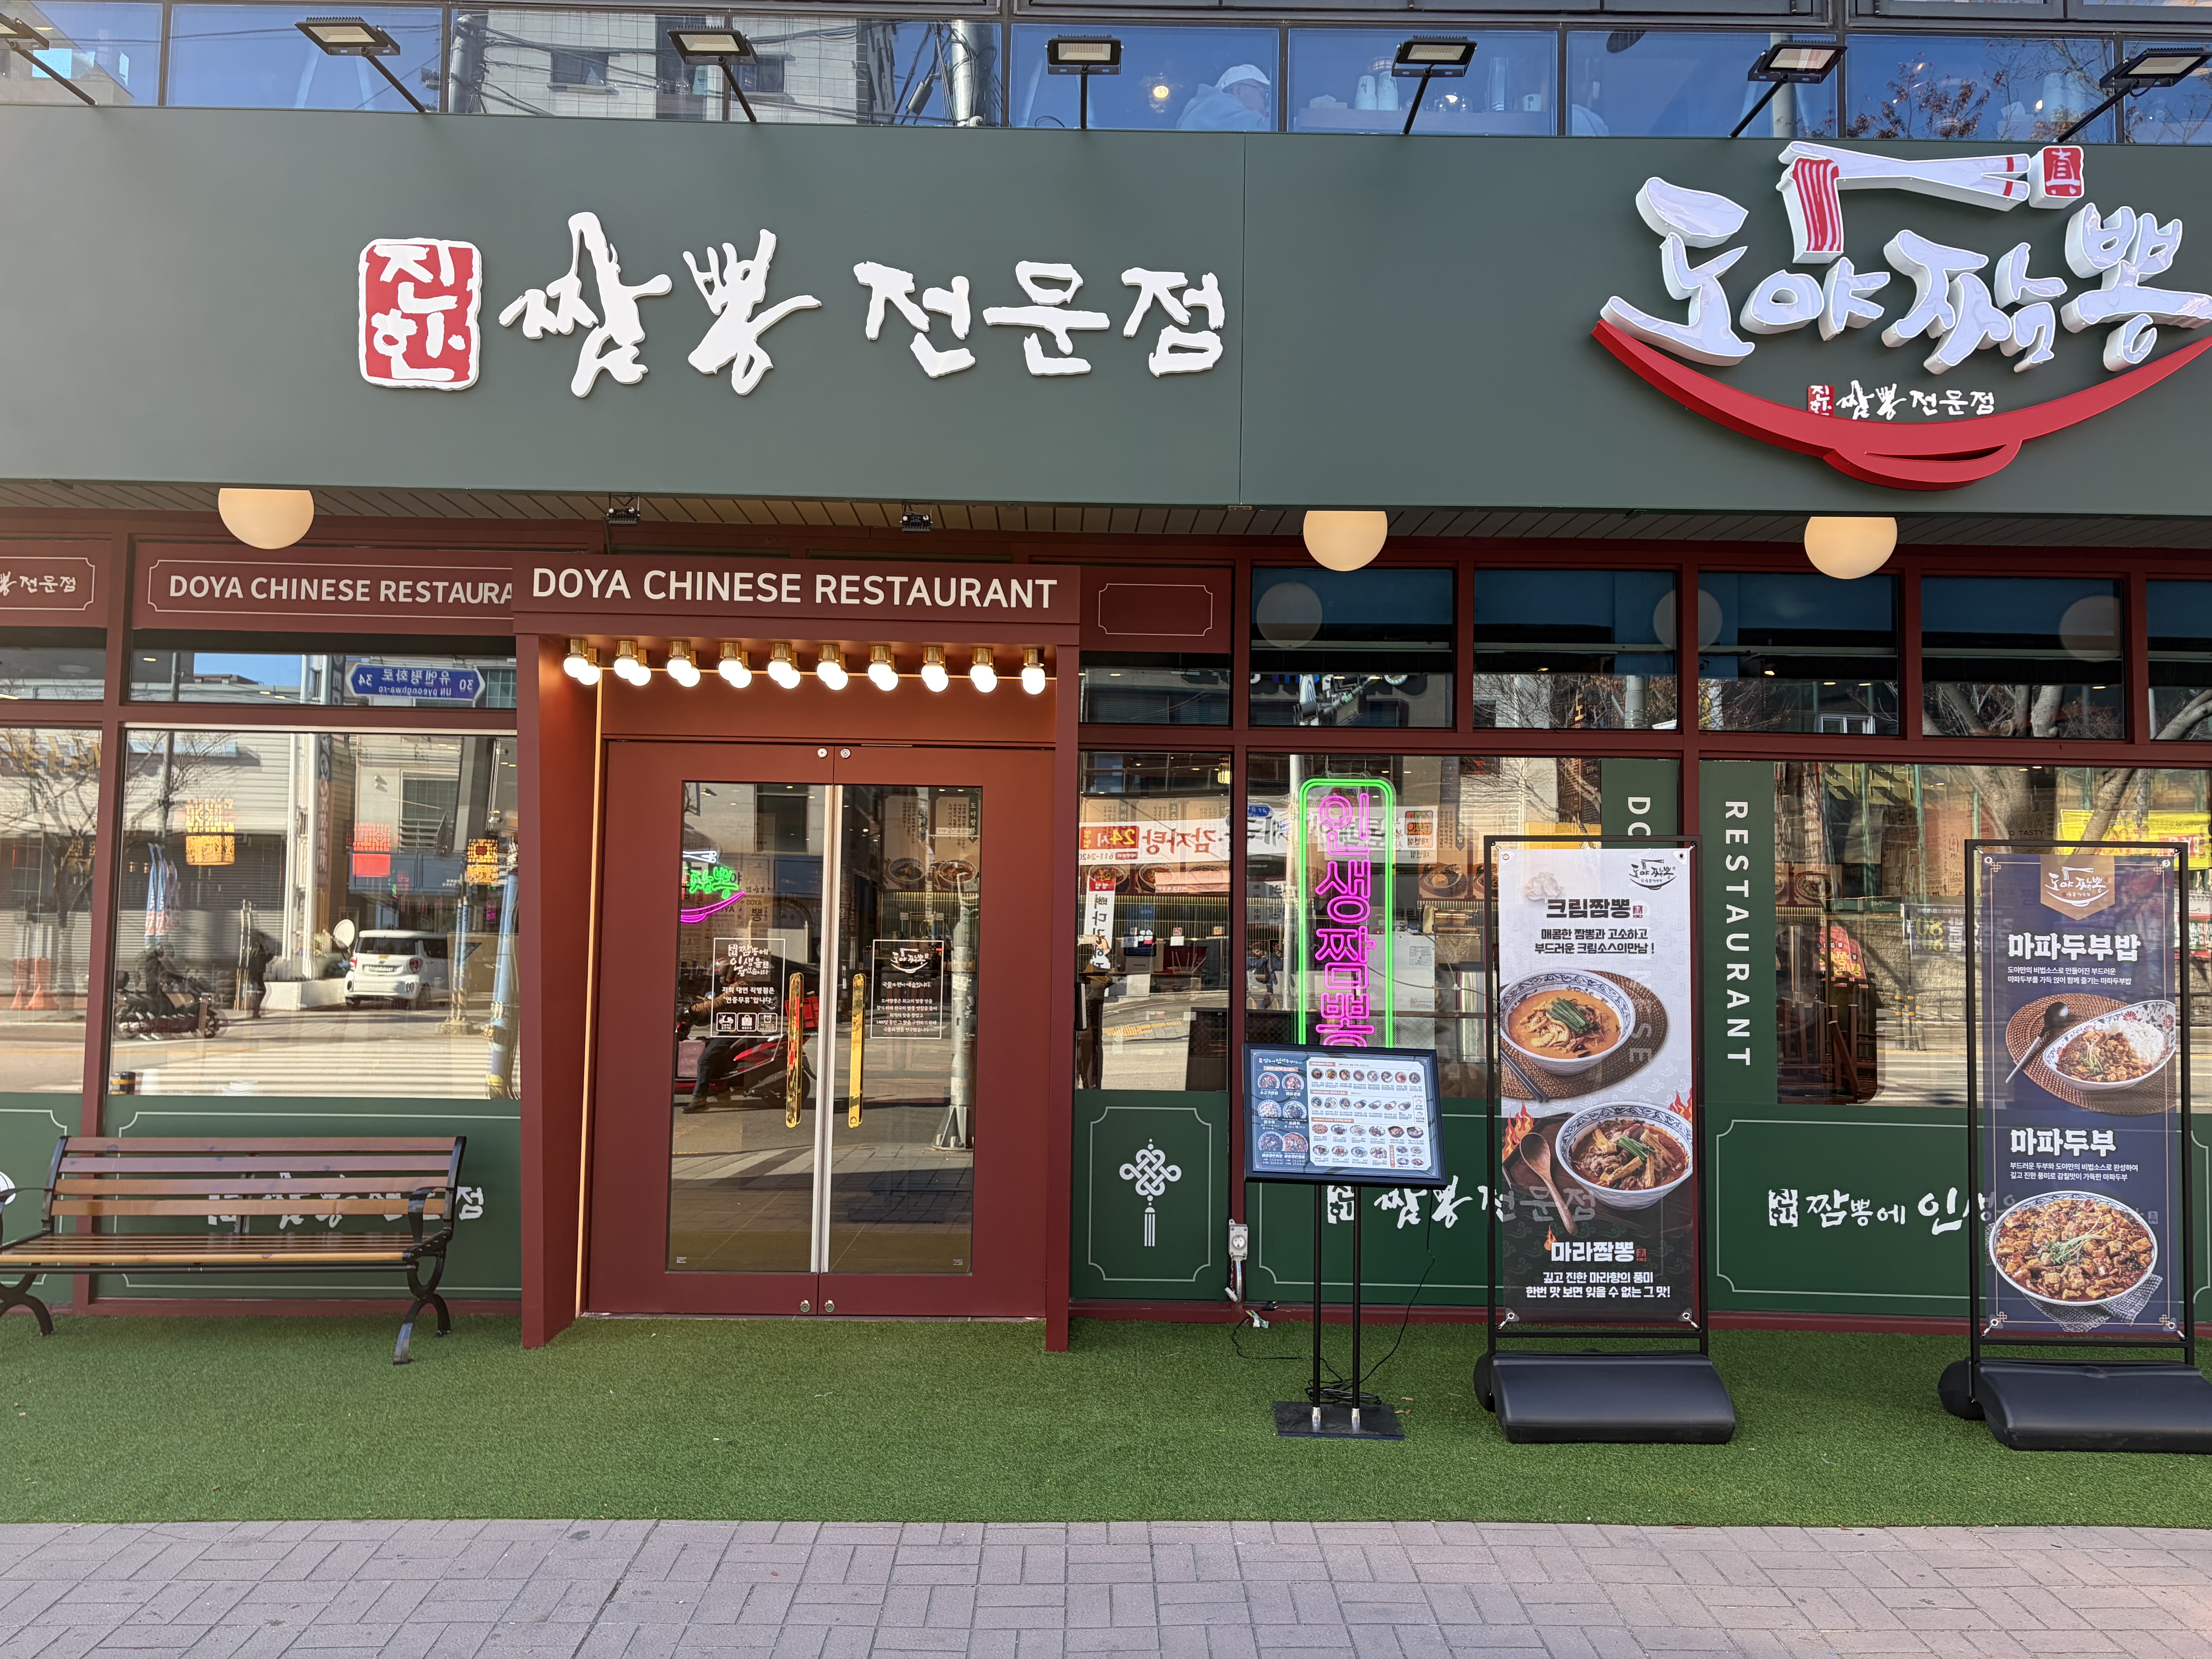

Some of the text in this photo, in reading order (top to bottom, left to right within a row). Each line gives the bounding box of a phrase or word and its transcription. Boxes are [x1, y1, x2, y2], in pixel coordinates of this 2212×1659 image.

[372, 212, 1224, 397] 진한 짬뽕 전문점
[1836, 380, 1907, 420] 짬뽕
[1909, 390, 1994, 416] 전문점
[19, 575, 76, 593] 전문점
[169, 575, 244, 599] DOYA
[251, 577, 371, 602] CHINESE
[533, 568, 1058, 609] DOYA CHINESE RESTAURANT
[1315, 793, 1376, 1047] 인생짬뽕
[1547, 899, 1631, 919] 크림짬뽕
[1541, 929, 1648, 939] 매콤한 짬뽕과 고소하고
[1725, 801, 1751, 1066] RESTAURANT
[739, 944, 768, 957] 짬뽕에
[1535, 943, 1575, 954] 부드러운
[2008, 933, 2141, 961] 마파두부밥
[730, 955, 763, 971] 인생을
[2011, 1128, 2116, 1156] 마파두부
[1806, 1189, 1905, 1228] 짬뽕에
[1551, 1242, 1635, 1262] 마라짬뽕
[1543, 1272, 1653, 1283] 깊고 진한 마라향의 풍미
[1526, 1286, 1670, 1298] 한번 맛 보면 잊을 수 없는 그 맛!
